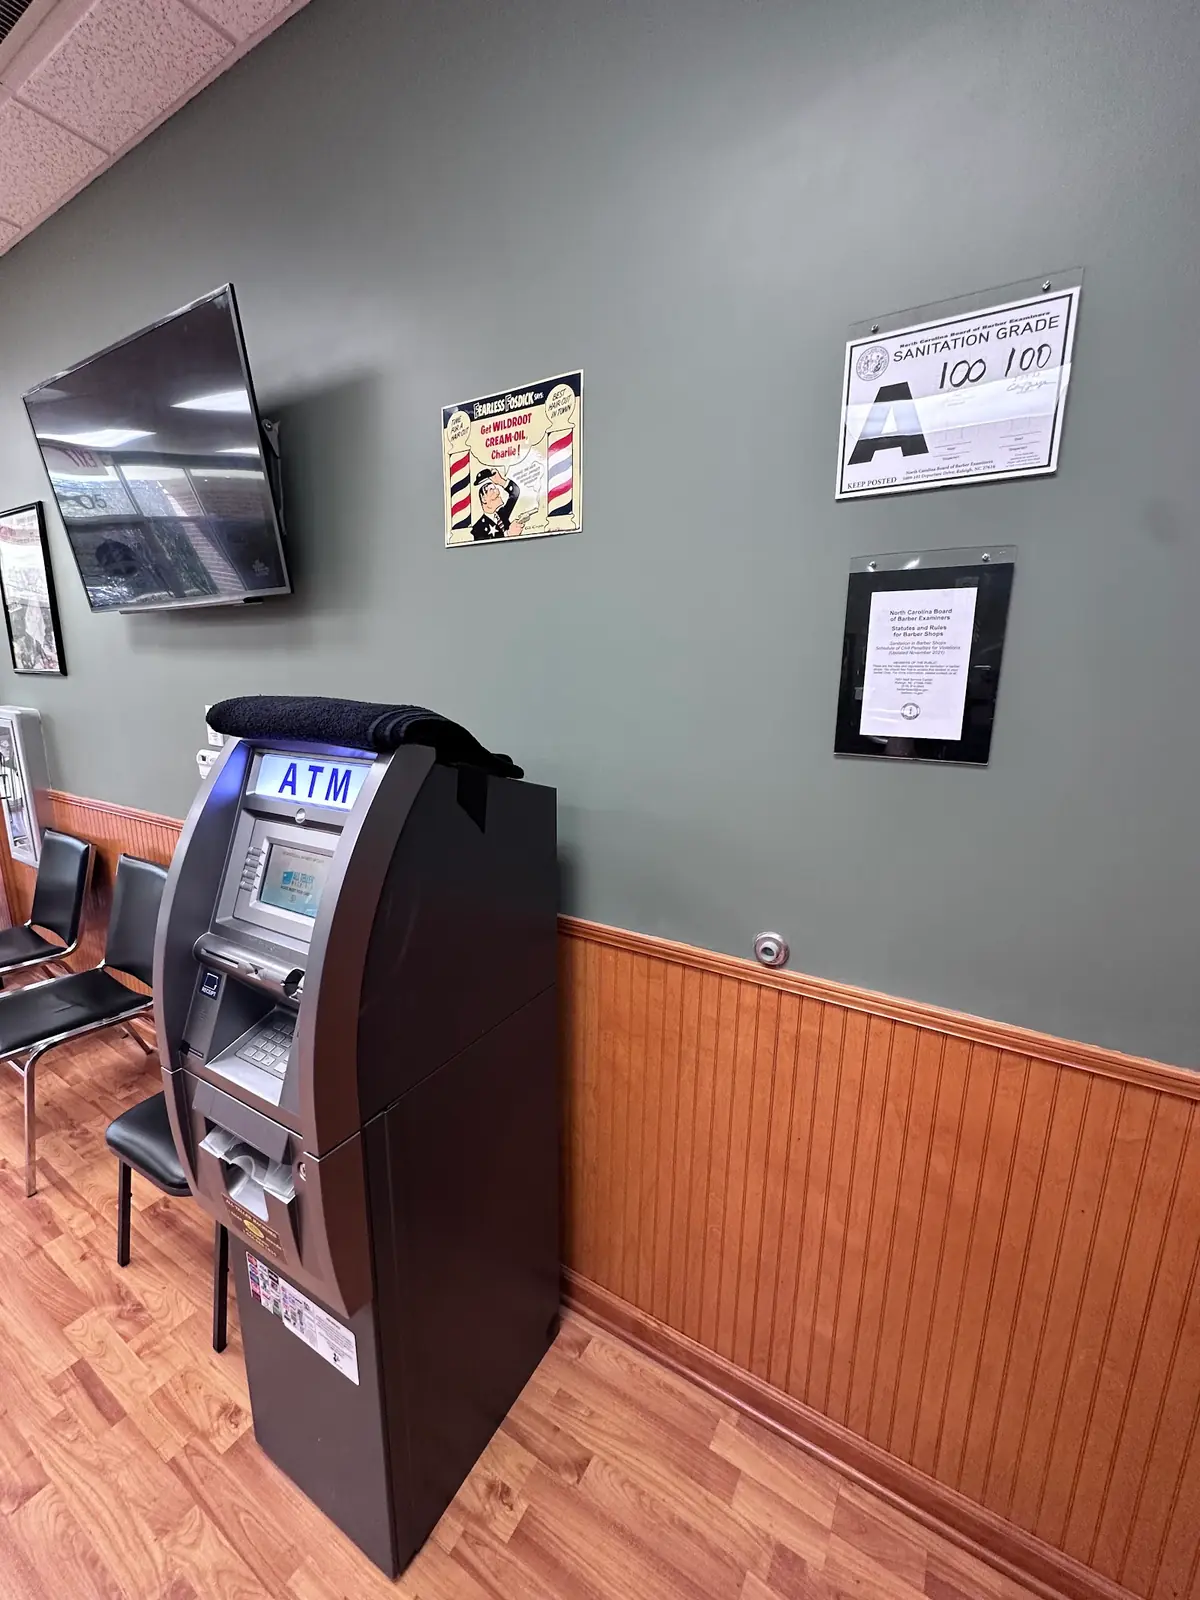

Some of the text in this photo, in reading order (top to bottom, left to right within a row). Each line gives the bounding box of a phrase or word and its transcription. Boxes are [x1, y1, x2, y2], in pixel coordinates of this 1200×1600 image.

[893, 315, 1060, 362] SANITATION GRADE
[900, 341, 918, 349] North
[920, 334, 949, 344] Carolina
[950, 328, 971, 337] Board
[982, 321, 1007, 331] Barber
[1009, 311, 1050, 324] Examiners
[939, 358, 987, 389] 100
[1005, 343, 1052, 378] 100
[473, 398, 505, 419] FEARLESS
[505, 391, 535, 412] FOSDICK
[552, 387, 567, 401] BEST
[480, 413, 533, 435] Get WILDROOT
[847, 381, 930, 466] A
[847, 476, 897, 489] KEEP POSTED
[278, 762, 352, 804] ATM
